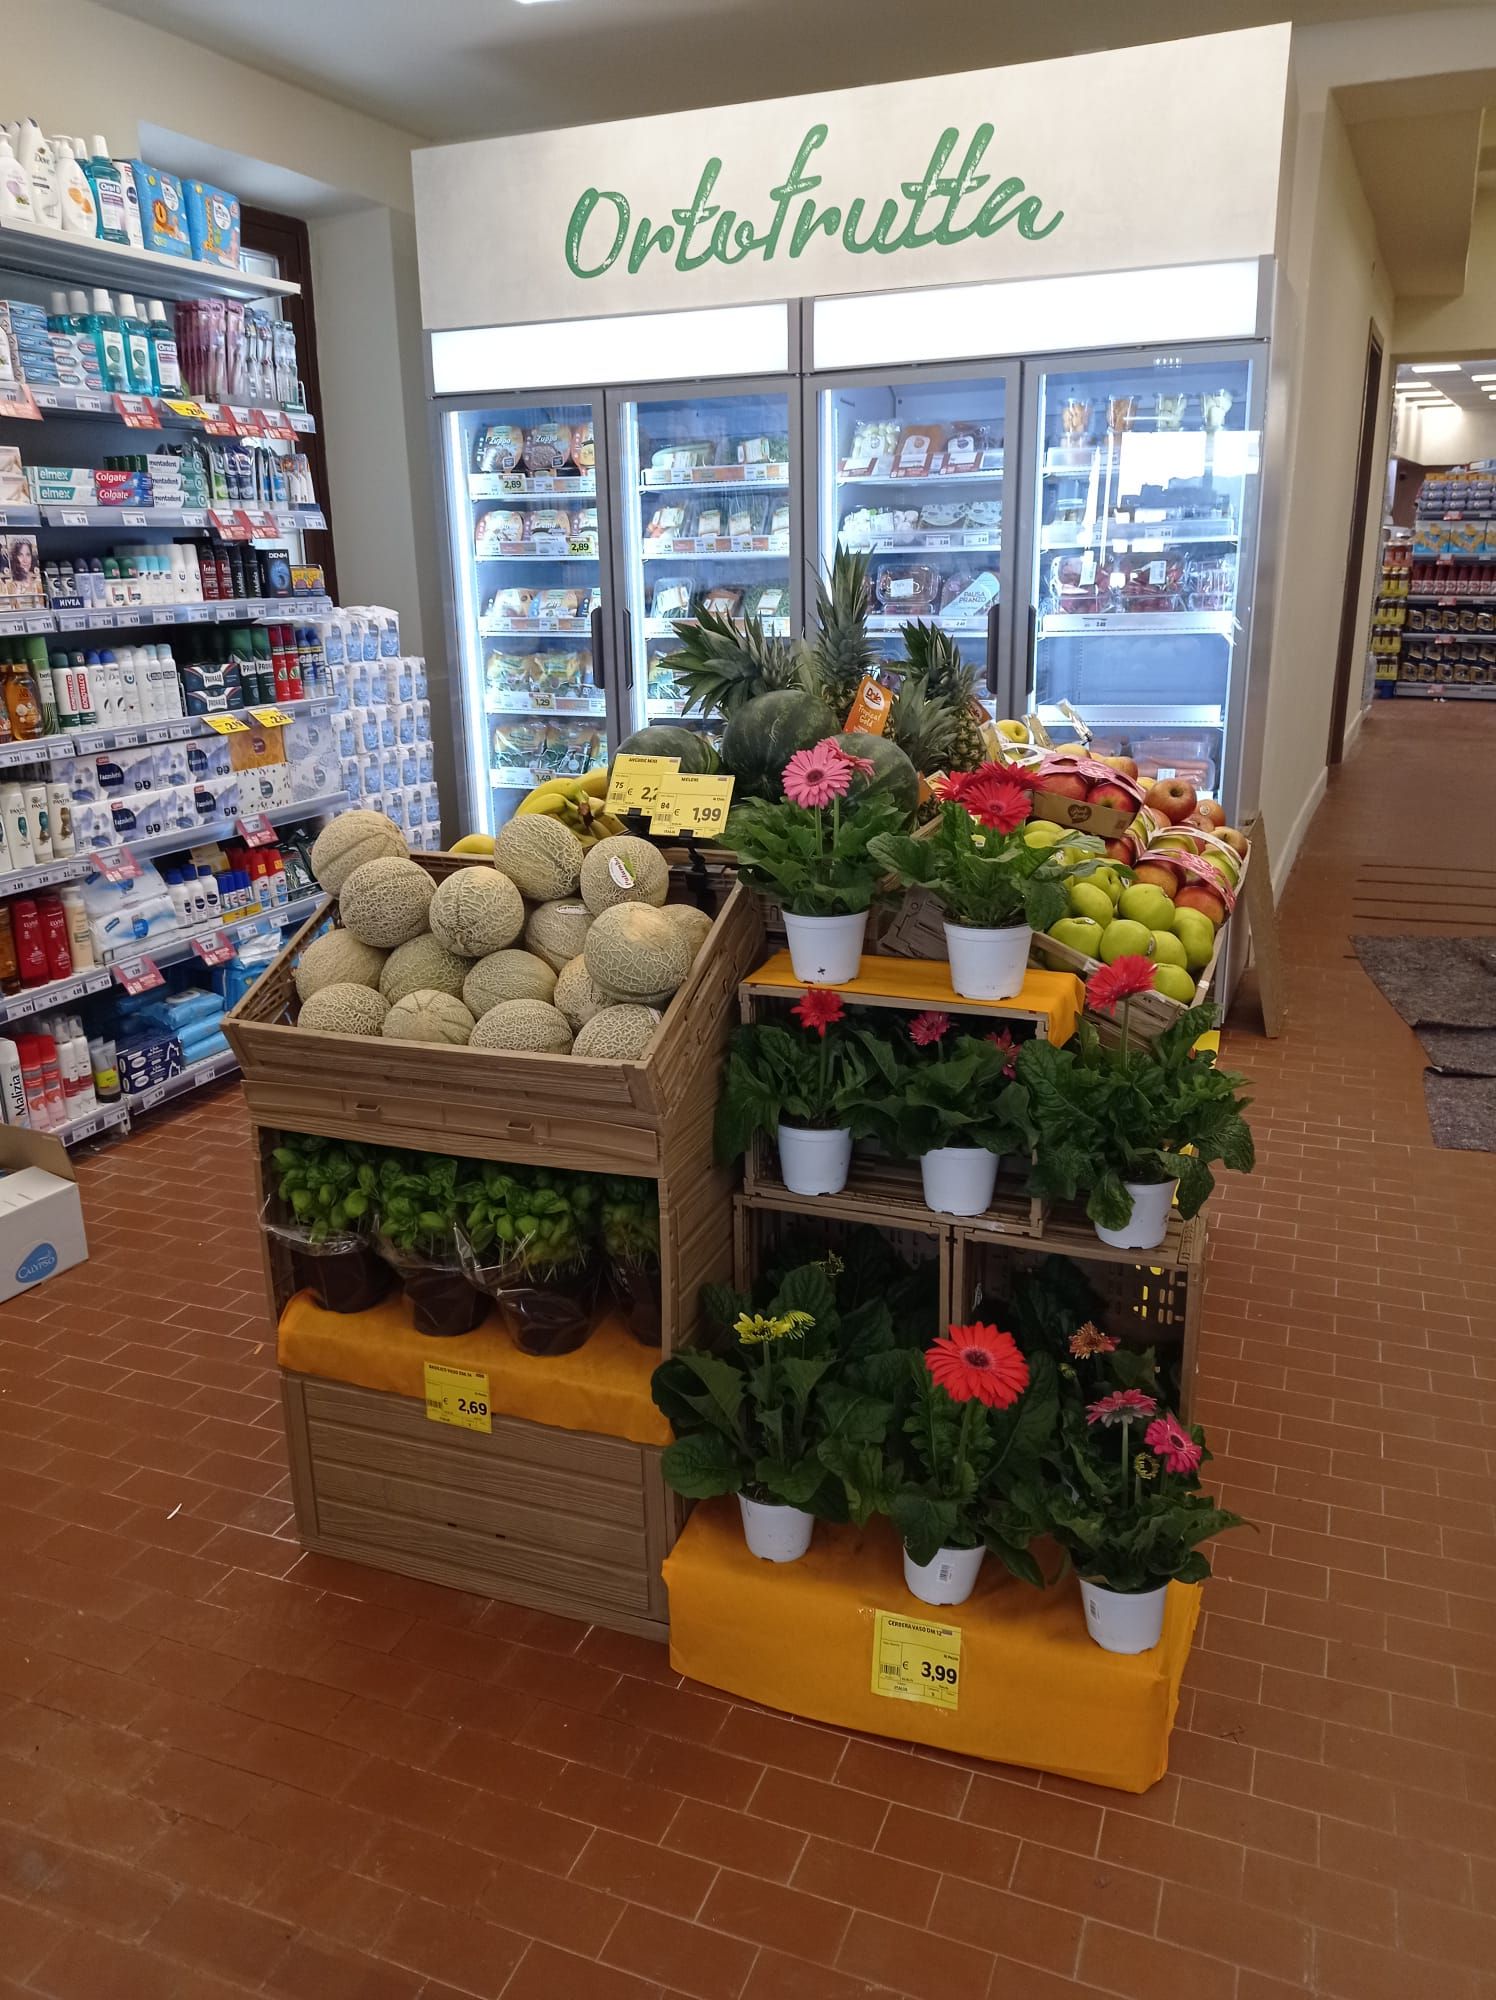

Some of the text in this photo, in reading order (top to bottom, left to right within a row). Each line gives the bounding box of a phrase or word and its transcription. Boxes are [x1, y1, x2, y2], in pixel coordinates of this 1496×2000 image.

[565, 123, 1064, 278] Ortofrutta
[149, 460, 178, 468] mentadent
[40, 469, 69, 481] elmex
[95, 472, 127, 484] Colgate
[151, 476, 179, 485] mentadent
[504, 480, 522, 490] 2,89
[41, 487, 71, 499] elmex
[99, 489, 129, 501] Colgate
[154, 494, 183, 502] mentadent
[571, 542, 589, 552] 2,89
[59, 599, 81, 607] NIVEA
[866, 687, 882, 702] Dole
[627, 788, 633, 796] €
[674, 808, 680, 816] €
[692, 807, 721, 823] 1,99
[10, 1074, 27, 1117] Malizia
[457, 1398, 488, 1416] 2,69
[911, 1624, 927, 1633] VASO
[902, 1660, 909, 1670] €
[920, 1661, 957, 1685] 3,99
